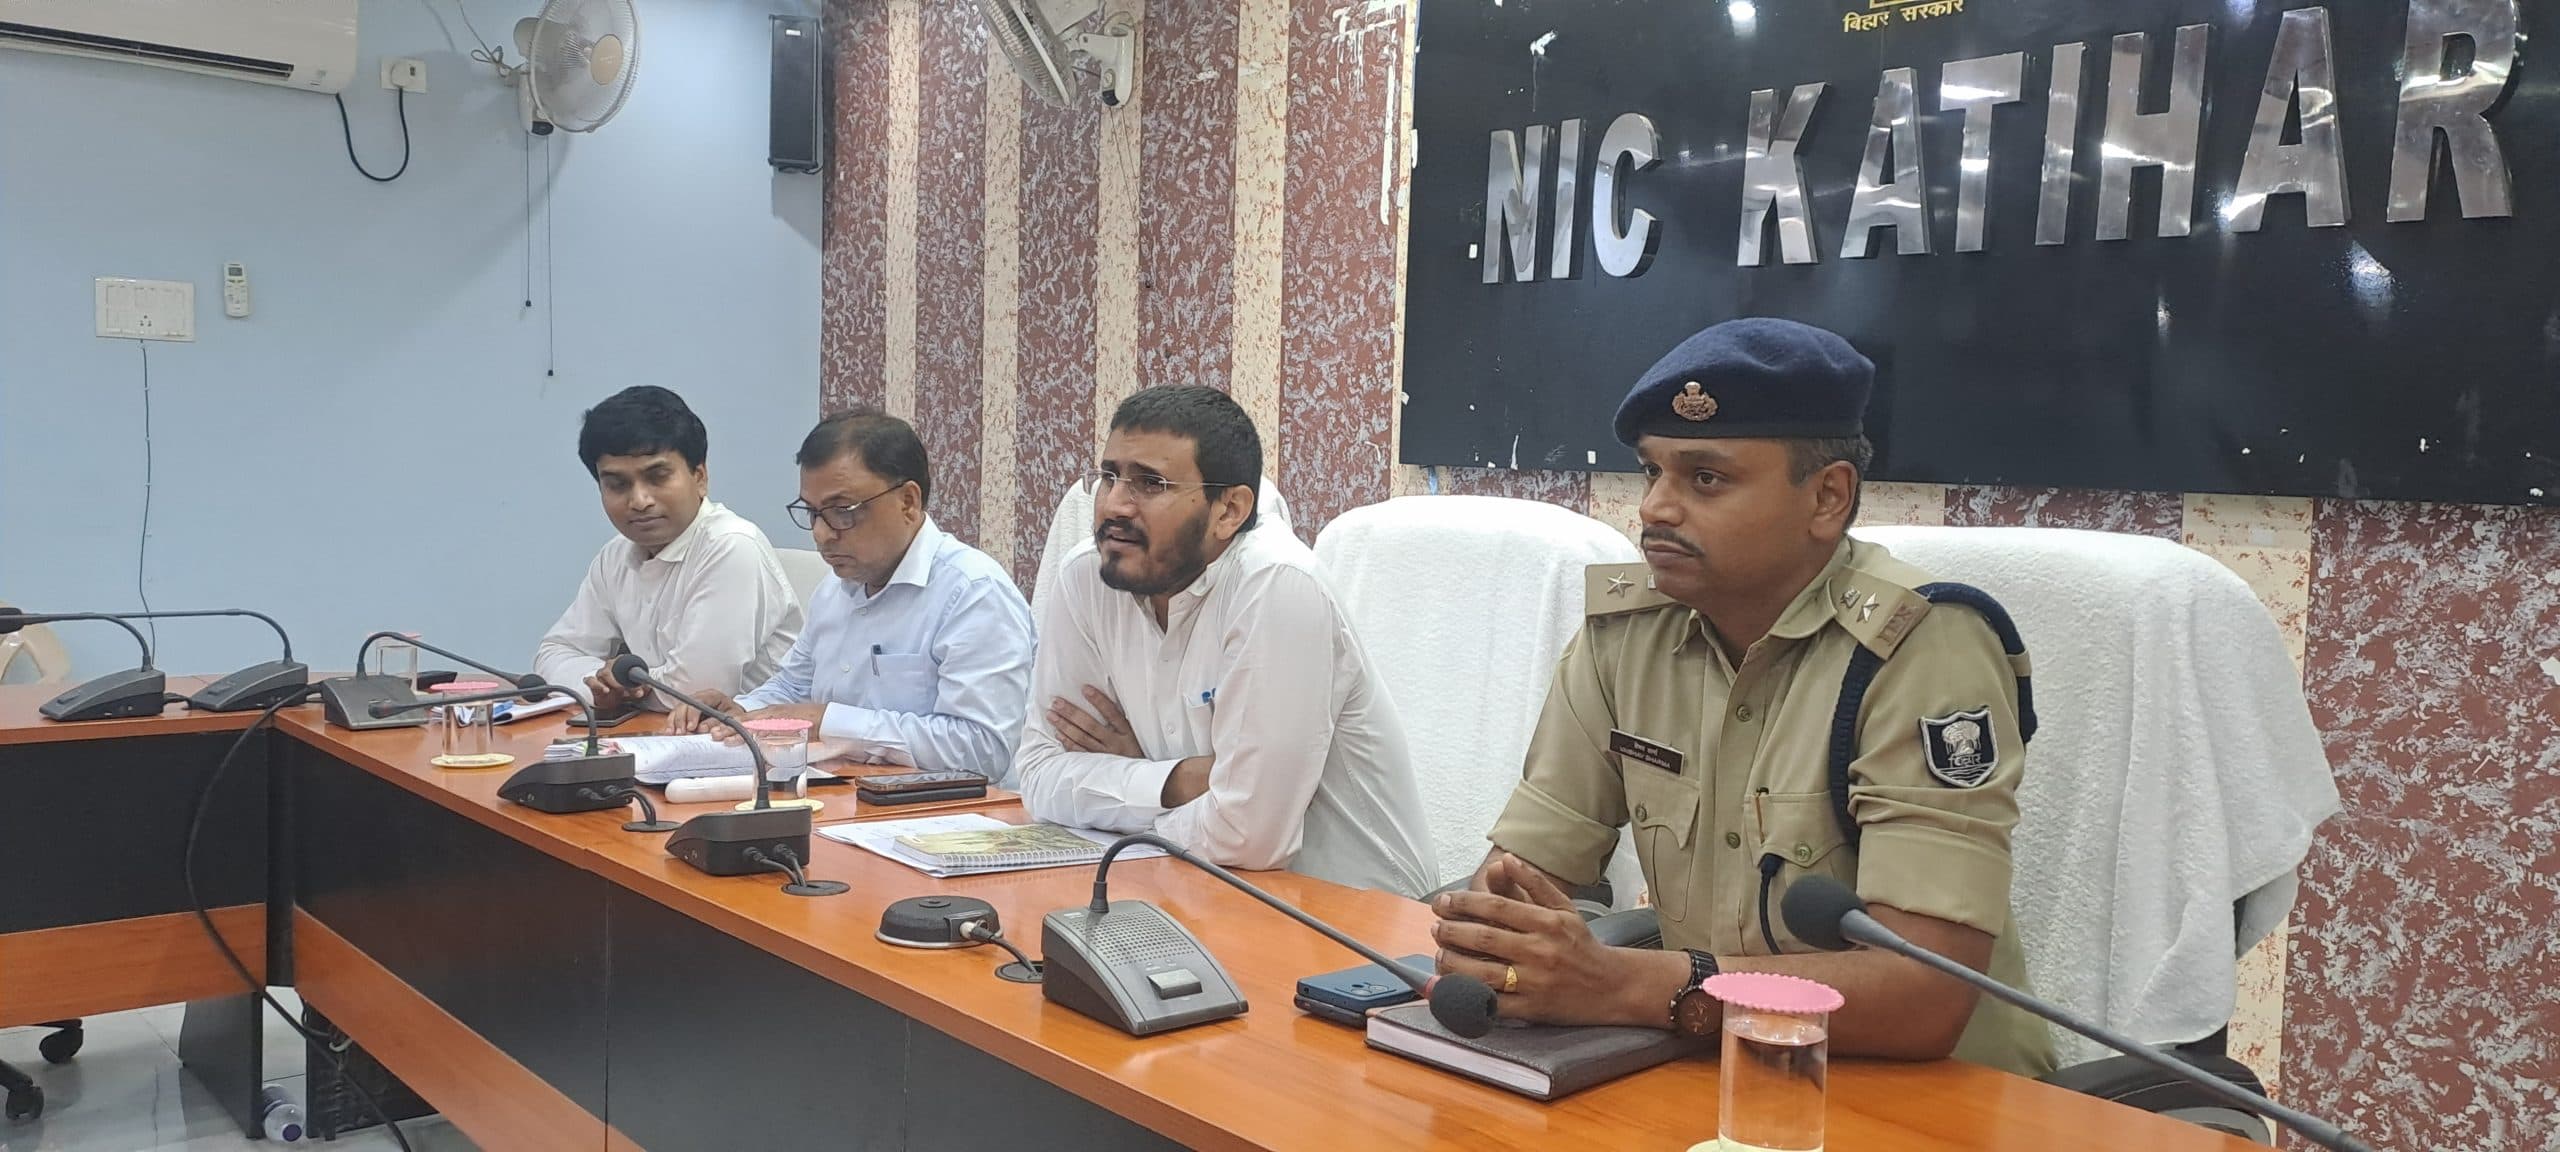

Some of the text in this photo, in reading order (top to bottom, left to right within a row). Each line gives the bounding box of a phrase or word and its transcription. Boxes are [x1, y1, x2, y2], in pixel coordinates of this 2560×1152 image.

[1842, 0, 1965, 33] बिहार सरकार
[1482, 0, 2517, 284] NIC KATIHAR
